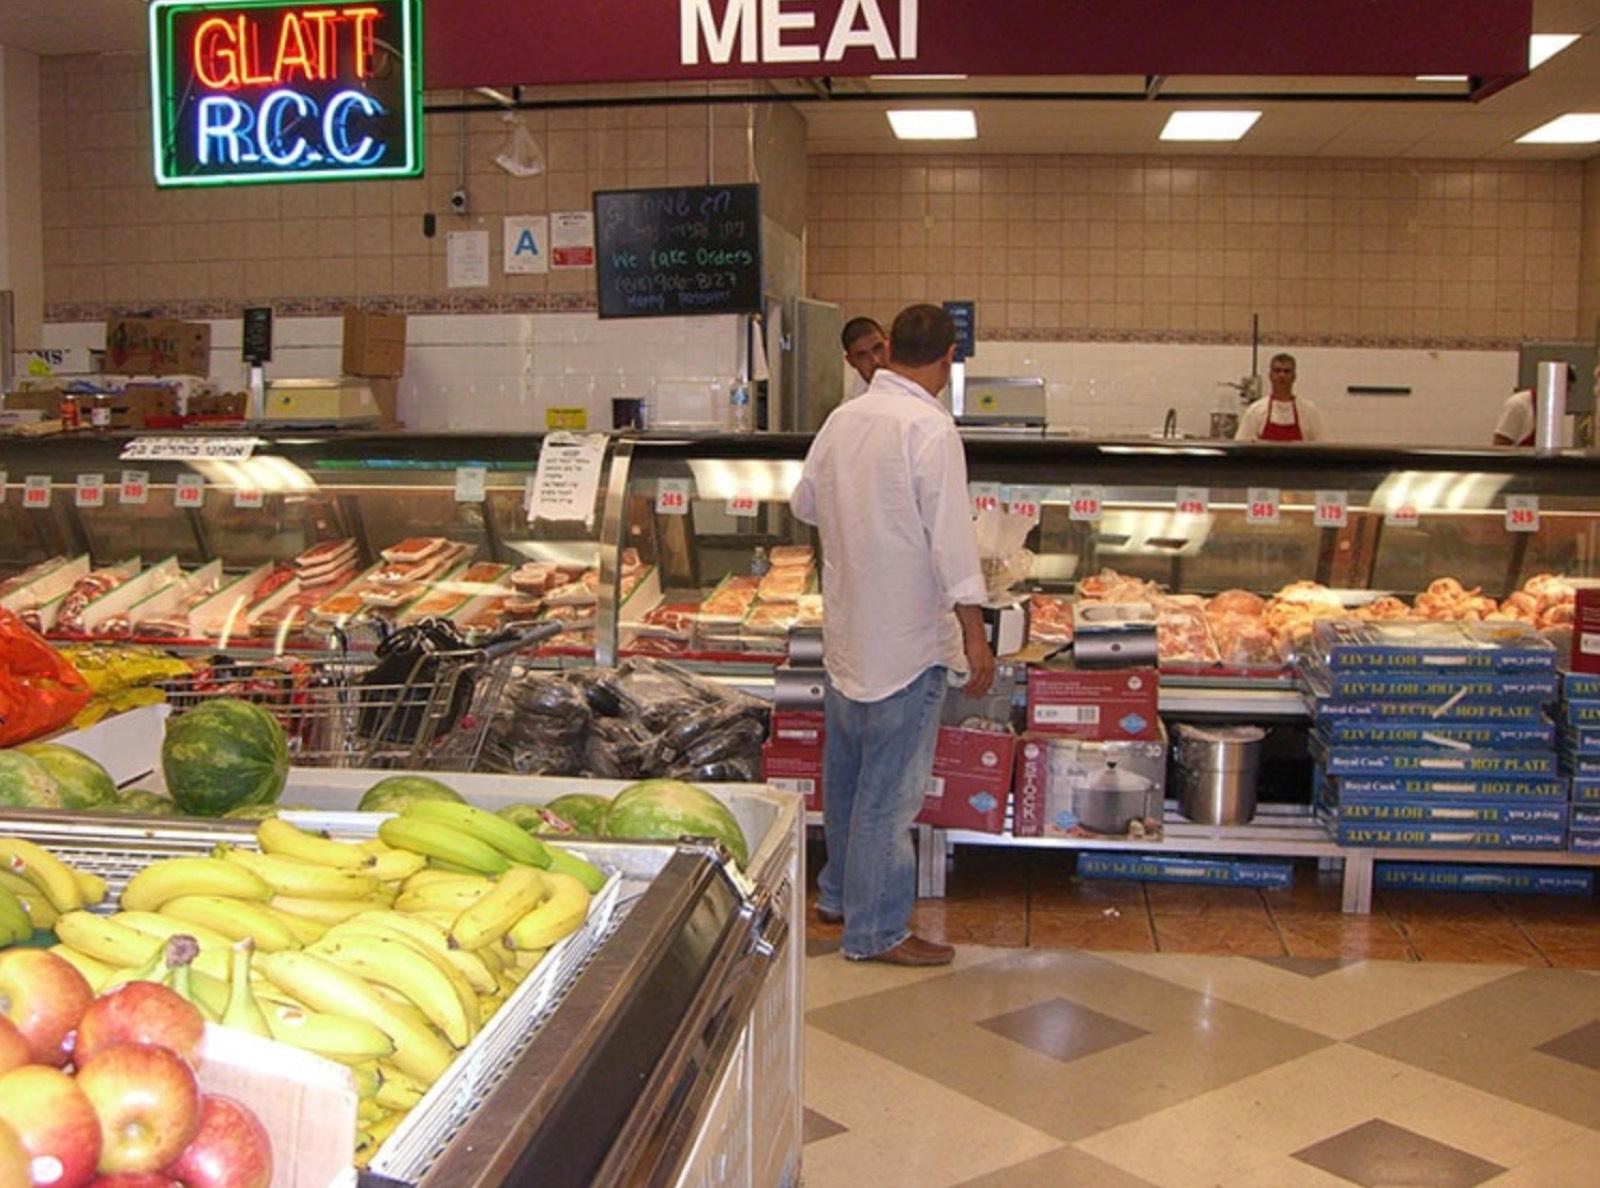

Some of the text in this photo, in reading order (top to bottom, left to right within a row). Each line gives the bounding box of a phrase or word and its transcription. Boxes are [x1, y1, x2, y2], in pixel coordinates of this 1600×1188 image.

[194, 7, 379, 89] GLATT
[514, 229, 539, 256] A
[612, 252, 638, 269] We
[696, 248, 752, 267] Orders
[1022, 762, 1038, 819] STOCK
